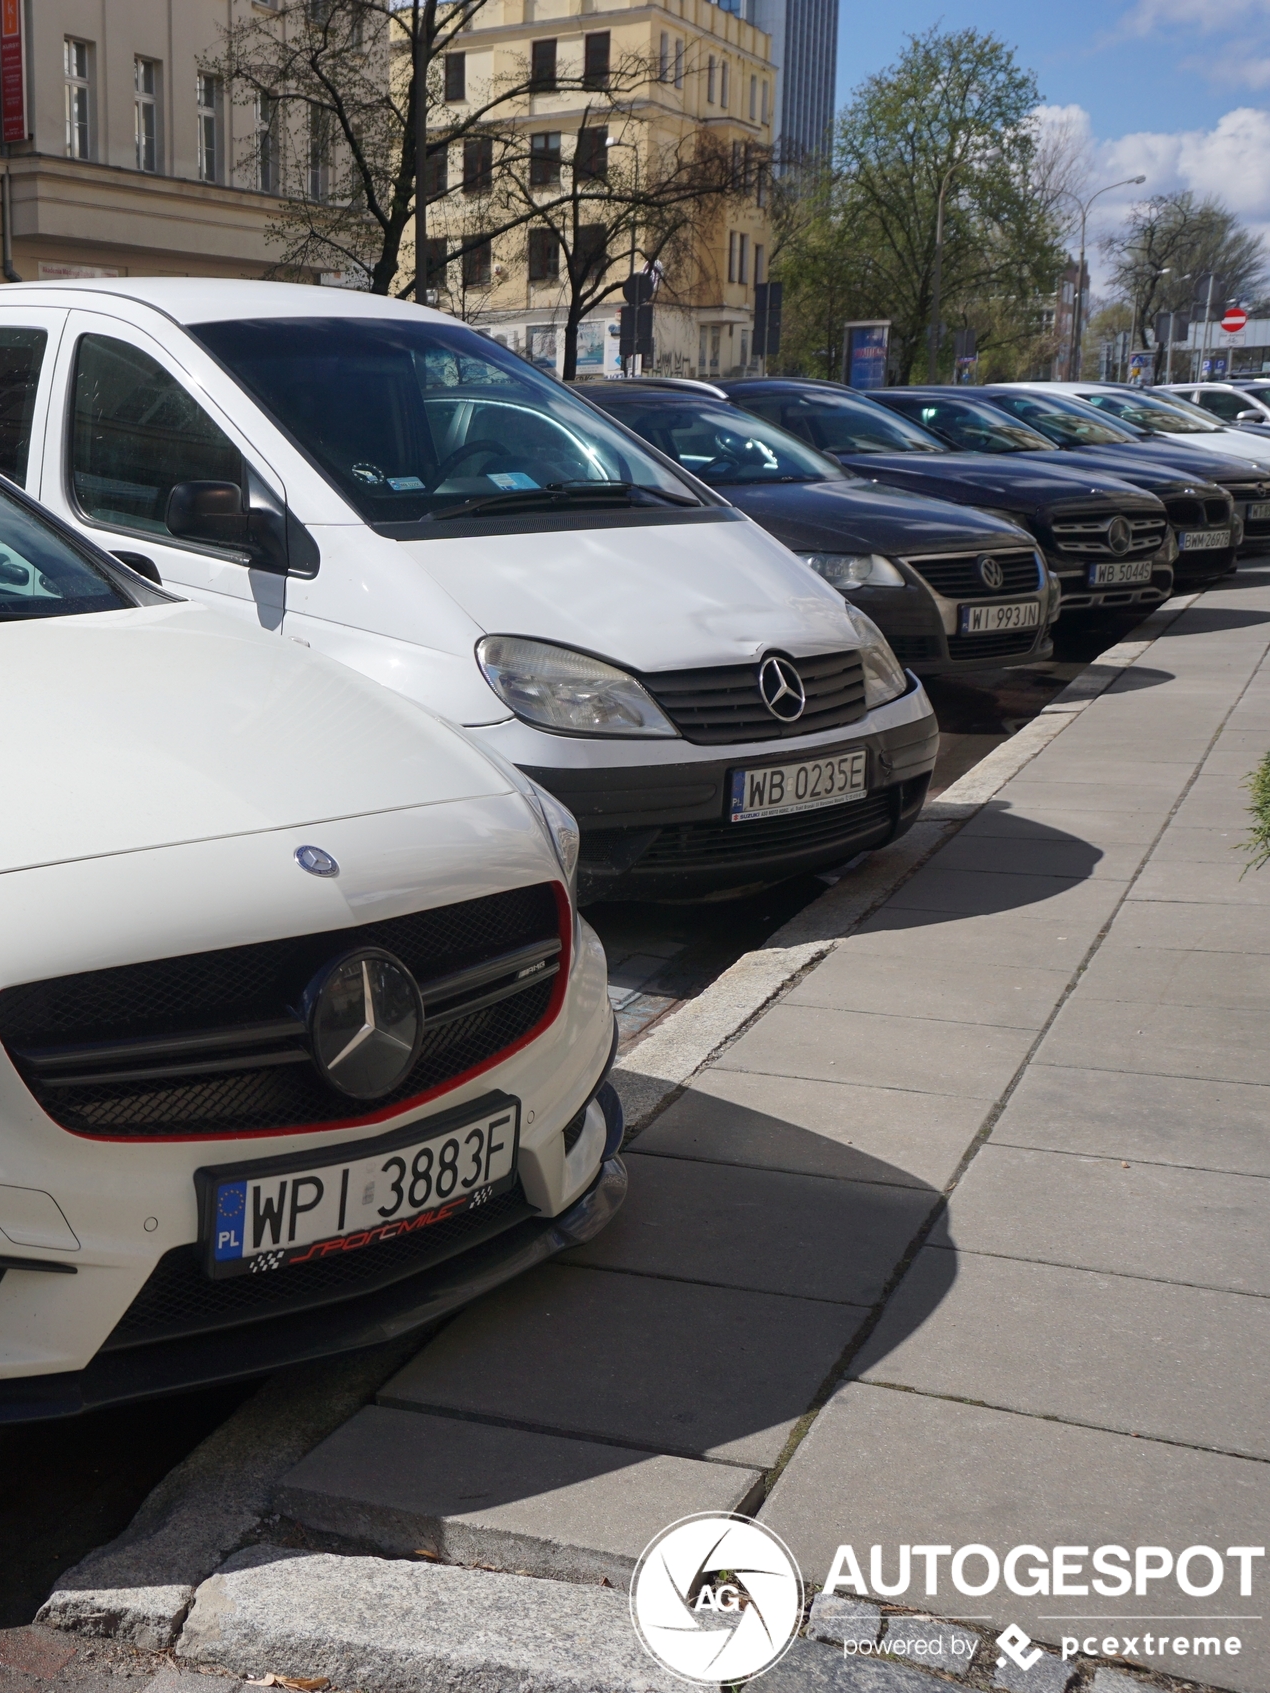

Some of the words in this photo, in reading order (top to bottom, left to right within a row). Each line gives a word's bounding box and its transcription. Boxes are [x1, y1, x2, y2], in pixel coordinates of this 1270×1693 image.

[1185, 533, 1204, 548] BWM
[1099, 565, 1115, 582] WB
[1119, 562, 1150, 581] 5044S
[972, 609, 990, 630] WI
[996, 604, 1037, 628] 993JN
[749, 769, 785, 808] WB
[795, 755, 863, 800] 0235E
[733, 798, 742, 807] PL
[740, 812, 760, 820] SUZUKI
[377, 1114, 511, 1218] 3883F
[218, 1231, 240, 1249] PL
